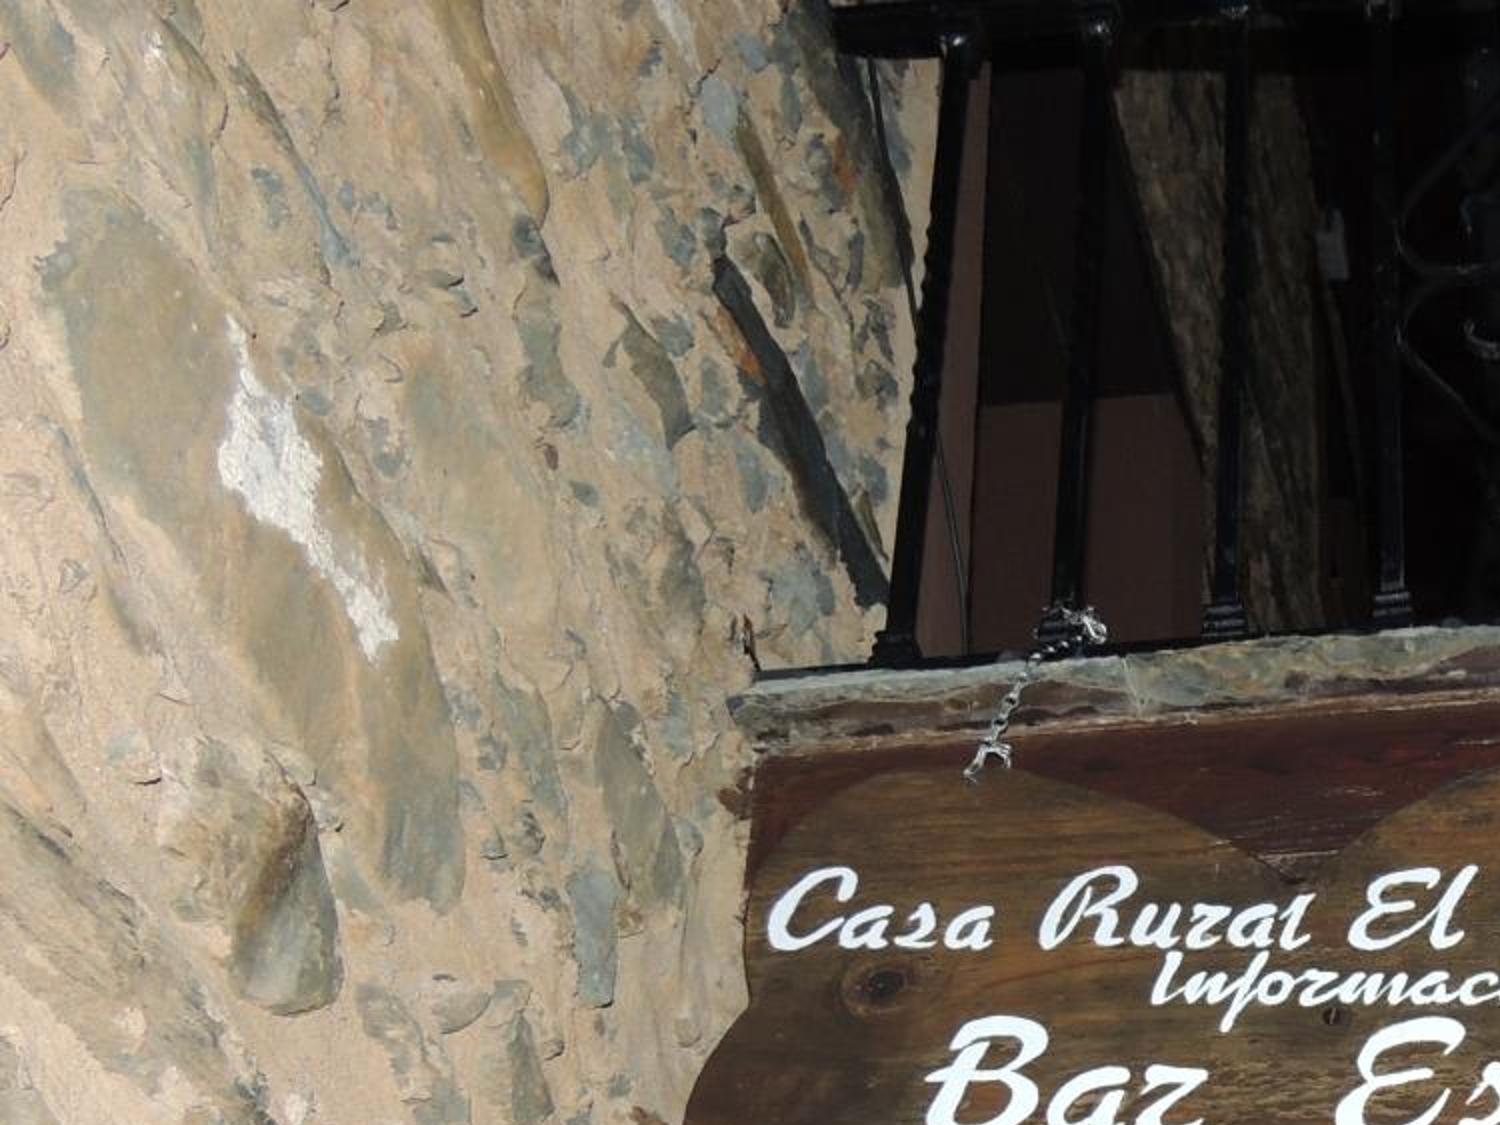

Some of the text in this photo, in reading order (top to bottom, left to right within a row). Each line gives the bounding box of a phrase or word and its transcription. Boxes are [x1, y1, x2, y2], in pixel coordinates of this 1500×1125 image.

[766, 865, 996, 951] Casa
[1038, 865, 1317, 952] Rural
[1347, 864, 1479, 952] El
